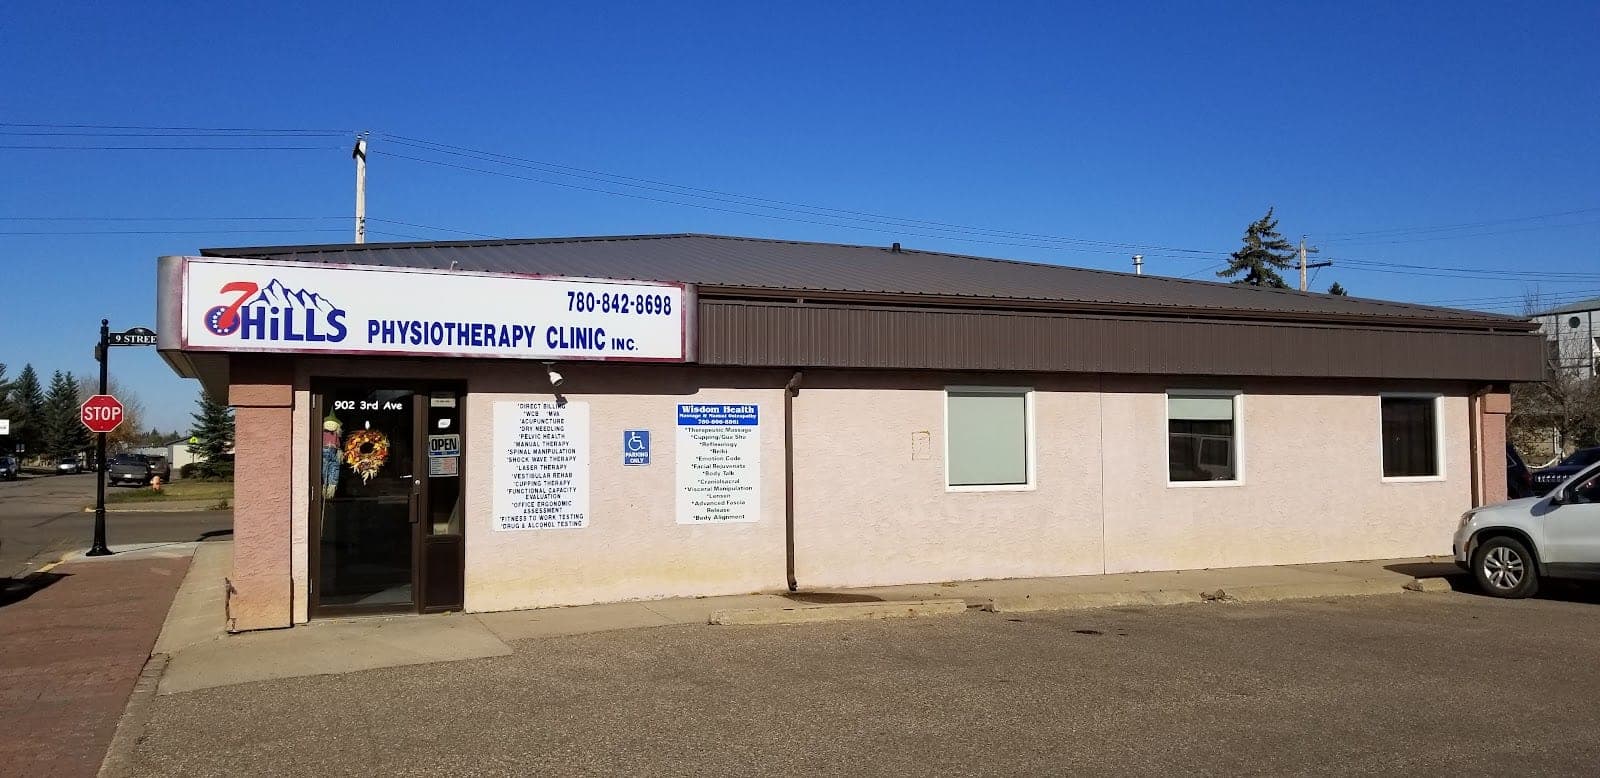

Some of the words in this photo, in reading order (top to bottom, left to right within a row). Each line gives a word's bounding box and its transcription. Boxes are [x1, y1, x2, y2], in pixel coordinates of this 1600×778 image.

[568, 291, 671, 316] 780-842-8698
[368, 319, 536, 348] PHYSIOTHERAPY
[546, 326, 605, 350] CLINIC
[611, 338, 639, 351] INC.
[335, 401, 355, 410] 902
[360, 401, 379, 410] 3rd
[383, 401, 403, 410] Ave
[84, 406, 121, 421] STOP
[432, 438, 456, 450] OPEN
